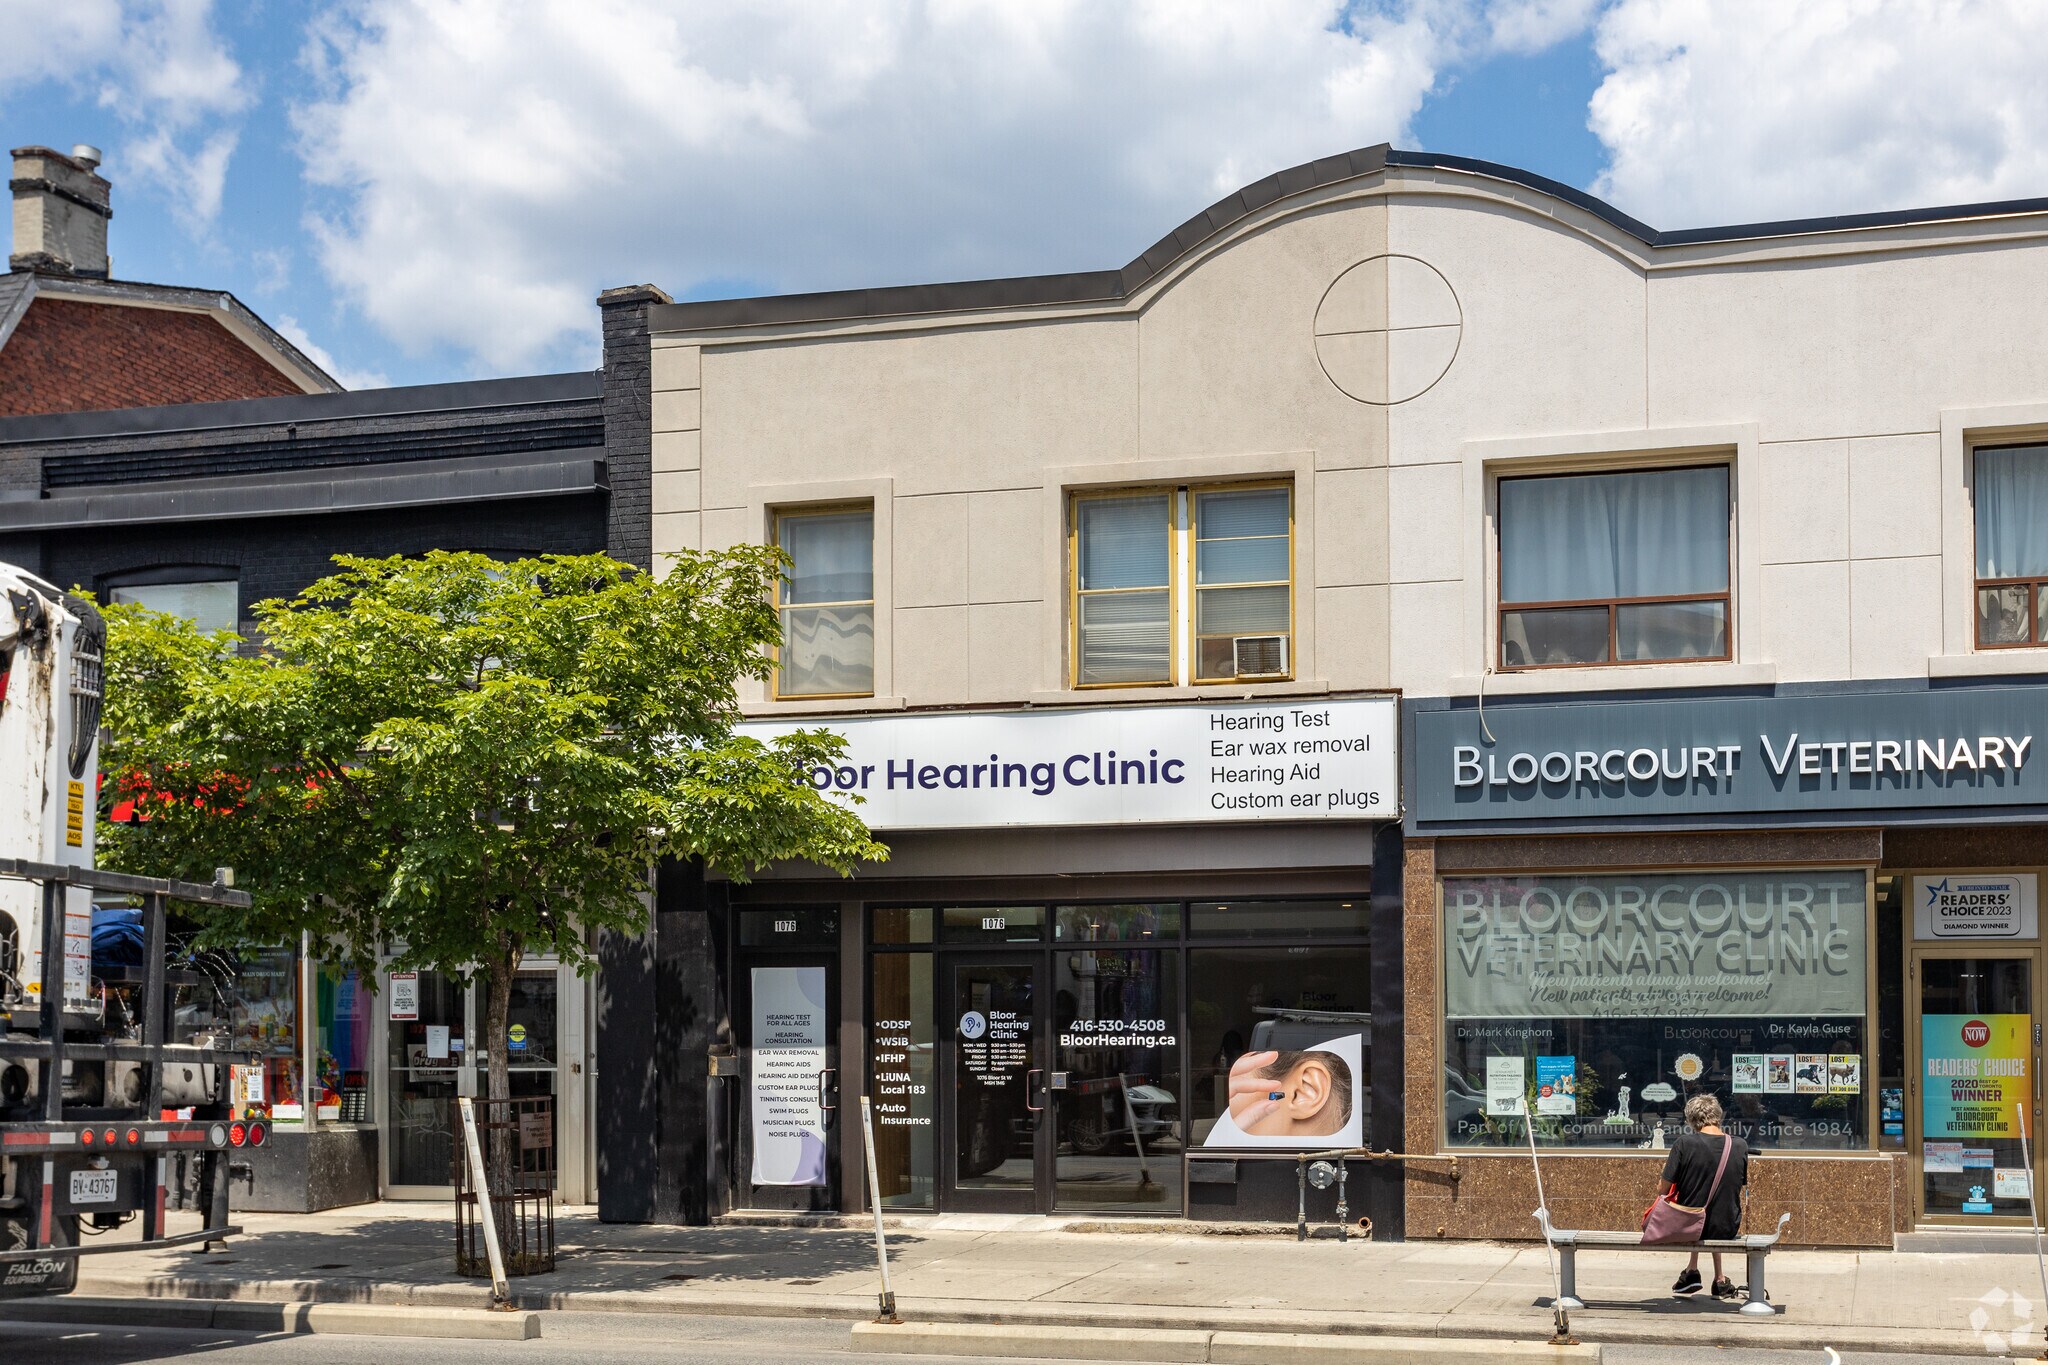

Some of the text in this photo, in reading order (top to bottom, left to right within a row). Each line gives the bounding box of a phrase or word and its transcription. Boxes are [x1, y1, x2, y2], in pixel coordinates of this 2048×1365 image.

[1211, 710, 1331, 732] Hearing Test
[1211, 734, 1370, 757] Ear wax removal
[887, 753, 1056, 796] Hearing
[1063, 749, 1185, 787] Clinic
[1211, 762, 1320, 785] Hearing Aid
[70, 783, 82, 791] KTL
[1211, 788, 1380, 810] Custom ear plugs
[68, 815, 82, 824] RRC
[1940, 894, 2010, 906] READERS'
[1457, 882, 1850, 930] BLOORCOURT
[1940, 906, 2012, 916] CHOICE 2023
[774, 921, 797, 932] 1076
[982, 918, 1005, 929] 1076
[1457, 928, 1850, 963] VETERINARY CLINIC
[1529, 969, 1773, 990] New patients always welcome!
[990, 1010, 1017, 1020] Bloor
[880, 1020, 912, 1029] ODSP
[990, 1020, 1030, 1031] Hearing
[1070, 1020, 1166, 1032] 416-530-4508
[1770, 1023, 1785, 1033] Dr.
[1788, 1023, 1819, 1036] Kayla
[1822, 1023, 1851, 1033] Guse
[990, 1030, 1018, 1039] Clinic
[1457, 1027, 1553, 1039] Dr. Mark Kinghorn
[1964, 1028, 1988, 1041] NOW
[880, 1037, 909, 1046] WSIB
[1060, 1033, 1176, 1048] BloorHearing.ca
[880, 1054, 906, 1062] IFHP
[1927, 1058, 2025, 1077] READERS' CHOICE
[880, 1072, 911, 1081] LiUNA
[1951, 1079, 1978, 1088] 2020
[881, 1085, 926, 1094] Local 183
[1951, 1090, 2002, 1101] WINNER
[880, 1104, 906, 1112] Auto
[881, 1115, 931, 1125] Insurance
[1955, 1112, 1998, 1121] BLOORCOURT
[1458, 1120, 1492, 1134] Part
[1497, 1119, 1514, 1134] of
[1563, 1120, 1655, 1139] community
[1758, 1121, 1804, 1135] since
[1809, 1122, 1853, 1136] 1984
[1946, 1121, 2009, 1131] VETERINARY CLINIC
[89, 1178, 116, 1194] 43767
[8, 1261, 66, 1275] FALCON
[3, 1274, 49, 1285] EQUIPMENT
